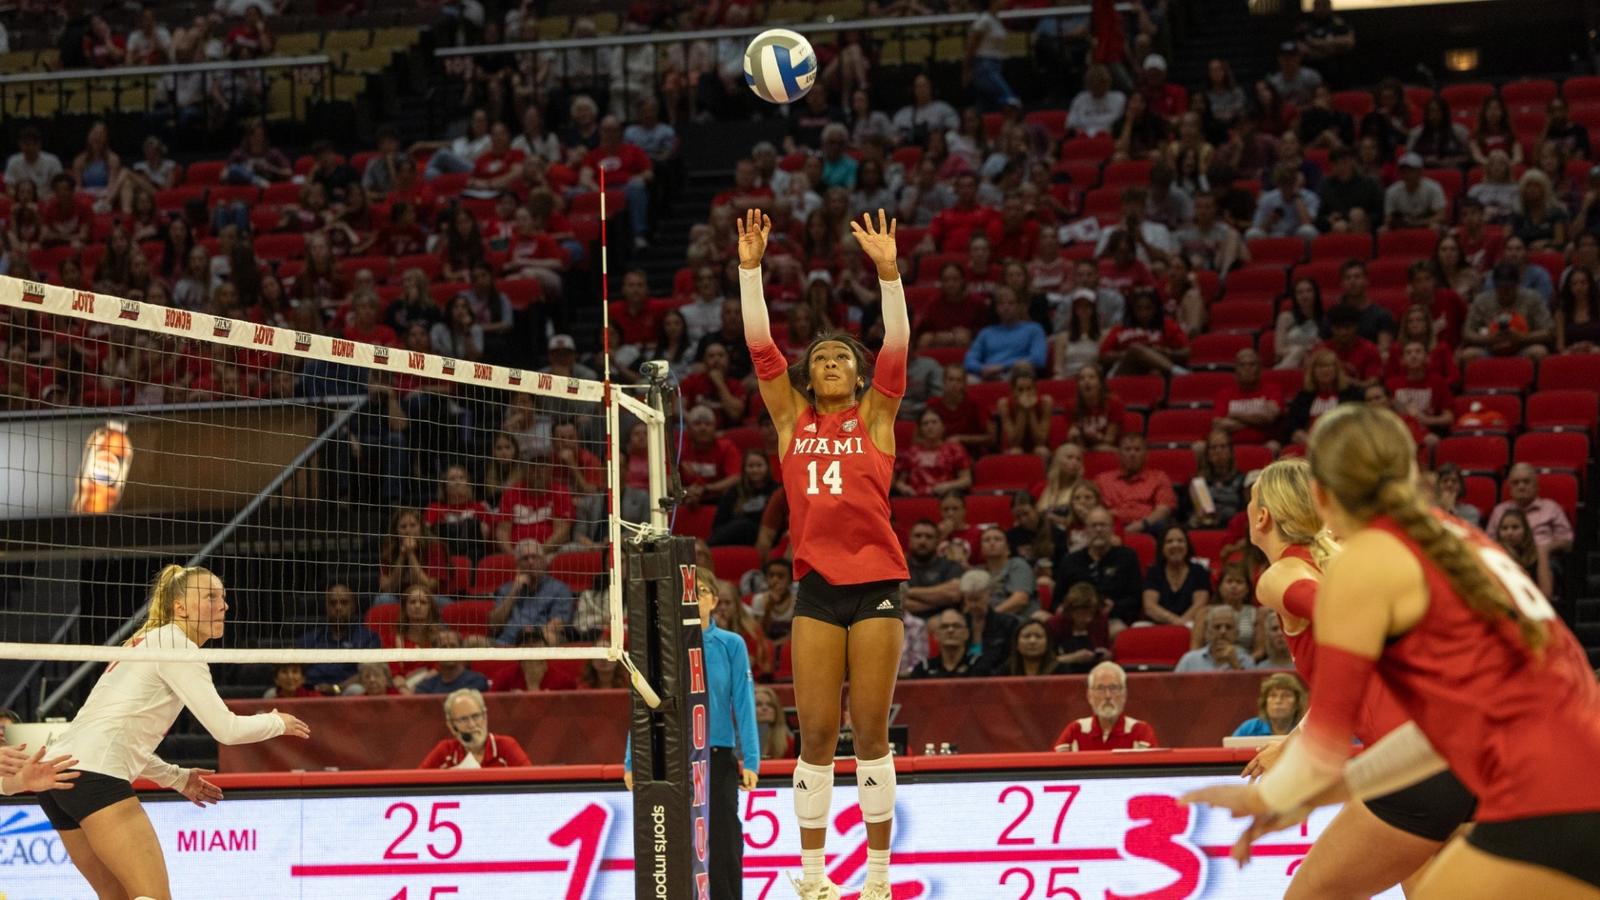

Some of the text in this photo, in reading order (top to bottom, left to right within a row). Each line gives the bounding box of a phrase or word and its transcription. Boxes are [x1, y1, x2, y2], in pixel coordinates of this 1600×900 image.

[71, 290, 96, 314] LOVE
[164, 308, 192, 331] HONOR
[253, 325, 275, 346] LOVE
[331, 339, 355, 359] HONOR
[793, 437, 864, 455] MIAMI
[806, 460, 843, 495] 14
[997, 785, 1081, 845] 27
[178, 829, 257, 852] MIAMI
[383, 802, 462, 860] 25
[651, 805, 668, 852] sports
[1104, 794, 1201, 900] 3
